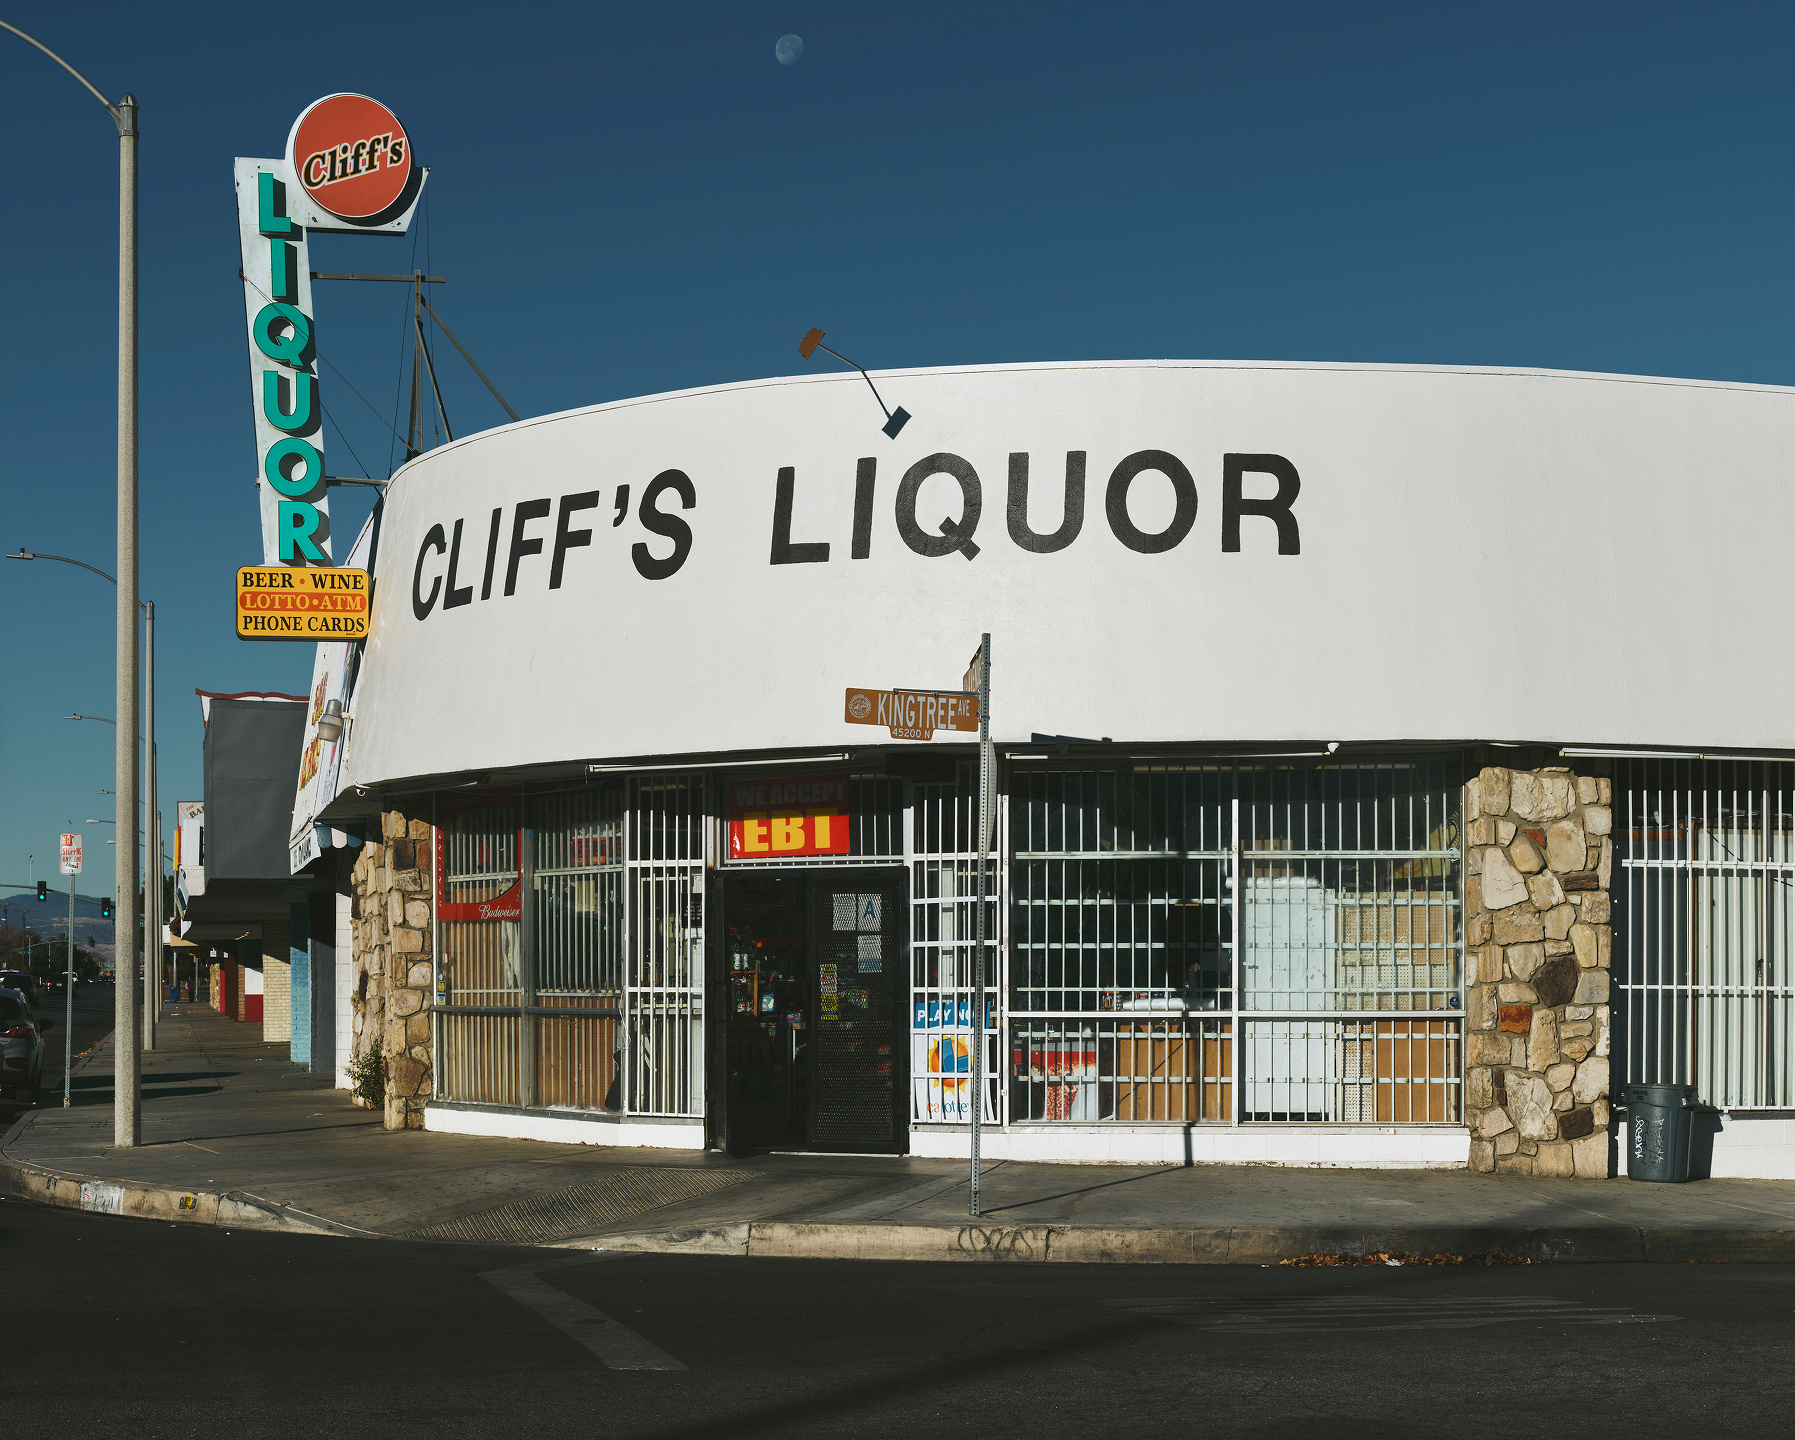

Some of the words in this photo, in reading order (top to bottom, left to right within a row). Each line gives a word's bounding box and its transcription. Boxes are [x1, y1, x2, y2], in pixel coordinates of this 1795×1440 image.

[302, 132, 405, 190] Cliff's
[253, 172, 325, 561] LIQUOR
[412, 468, 697, 622] CLIFF'S
[769, 449, 1302, 566] LIQUOR
[242, 572, 295, 588] BEER
[310, 573, 364, 590] WINE
[244, 593, 310, 610] LOTTO
[319, 595, 363, 610] ATM
[242, 615, 303, 631] PHONE
[307, 617, 365, 632] CARDS
[877, 693, 957, 730] KINGTREE
[957, 699, 970, 717] AVE
[892, 728, 922, 738] 45200
[924, 729, 931, 739] N
[734, 785, 767, 807] WE
[769, 780, 847, 805] ACCEPT
[743, 807, 838, 852] EBT
[479, 904, 521, 920] Budweiser
[863, 900, 876, 919] A
